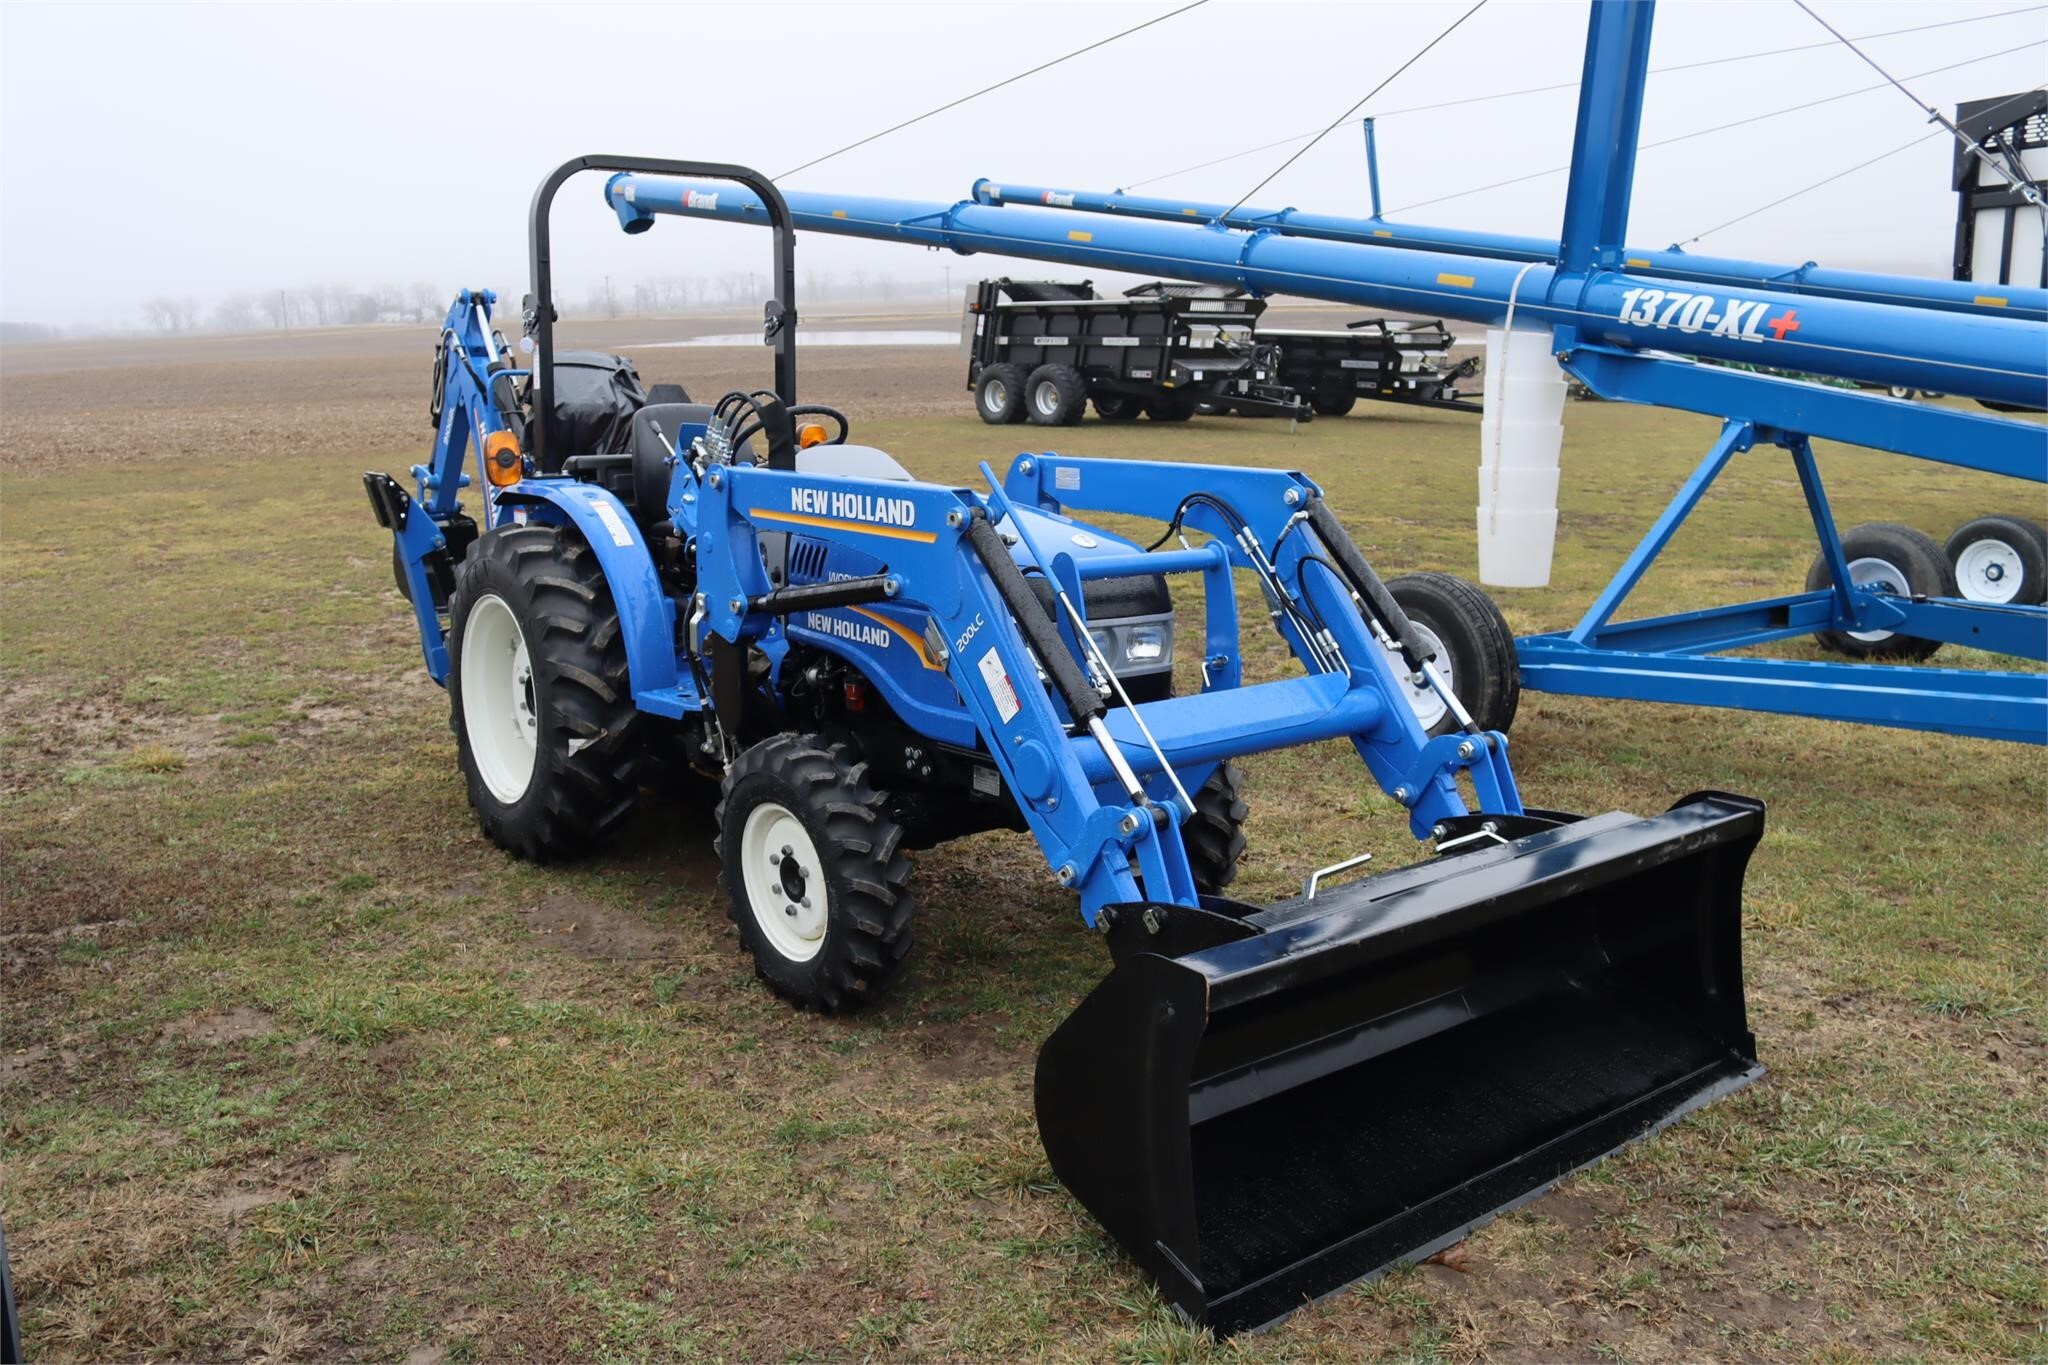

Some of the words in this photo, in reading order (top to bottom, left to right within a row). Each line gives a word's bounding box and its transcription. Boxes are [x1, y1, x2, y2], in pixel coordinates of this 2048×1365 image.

[791, 487, 828, 515] NEW
[832, 491, 916, 527] HOLLAND
[807, 611, 832, 634] NEW
[833, 621, 890, 649] HOLLAND
[955, 612, 985, 654] 200LC
